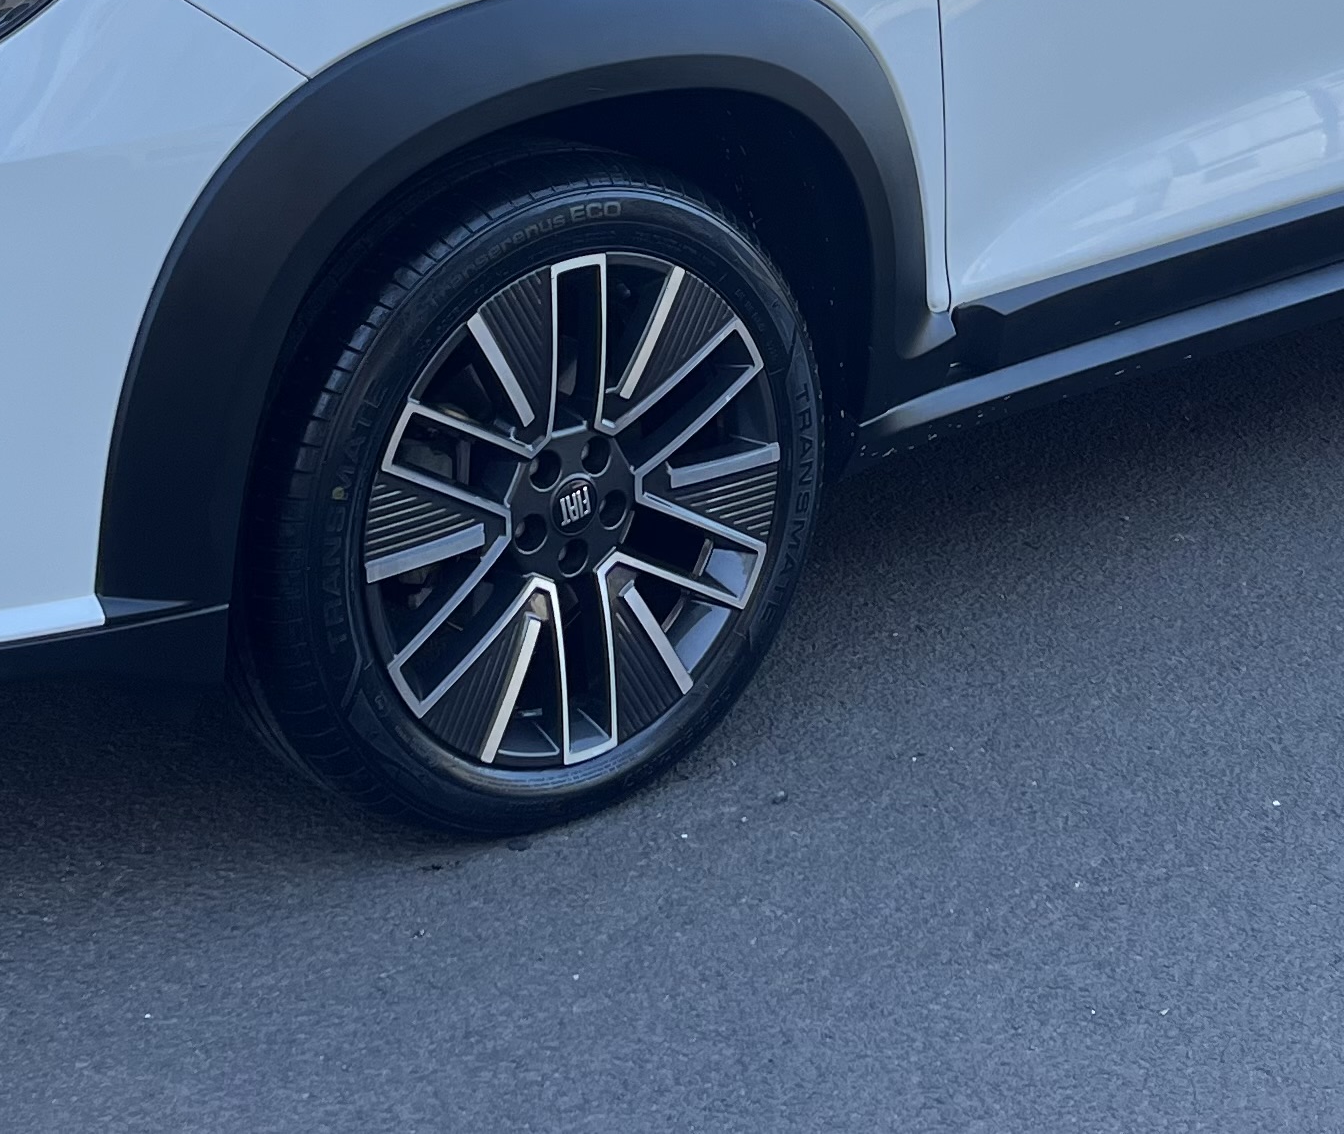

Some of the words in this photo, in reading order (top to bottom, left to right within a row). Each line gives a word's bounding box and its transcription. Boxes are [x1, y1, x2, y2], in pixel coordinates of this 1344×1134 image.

[570, 200, 622, 223] ECO
[560, 486, 592, 526] FIAT
[766, 382, 814, 624] TRANSMATE
